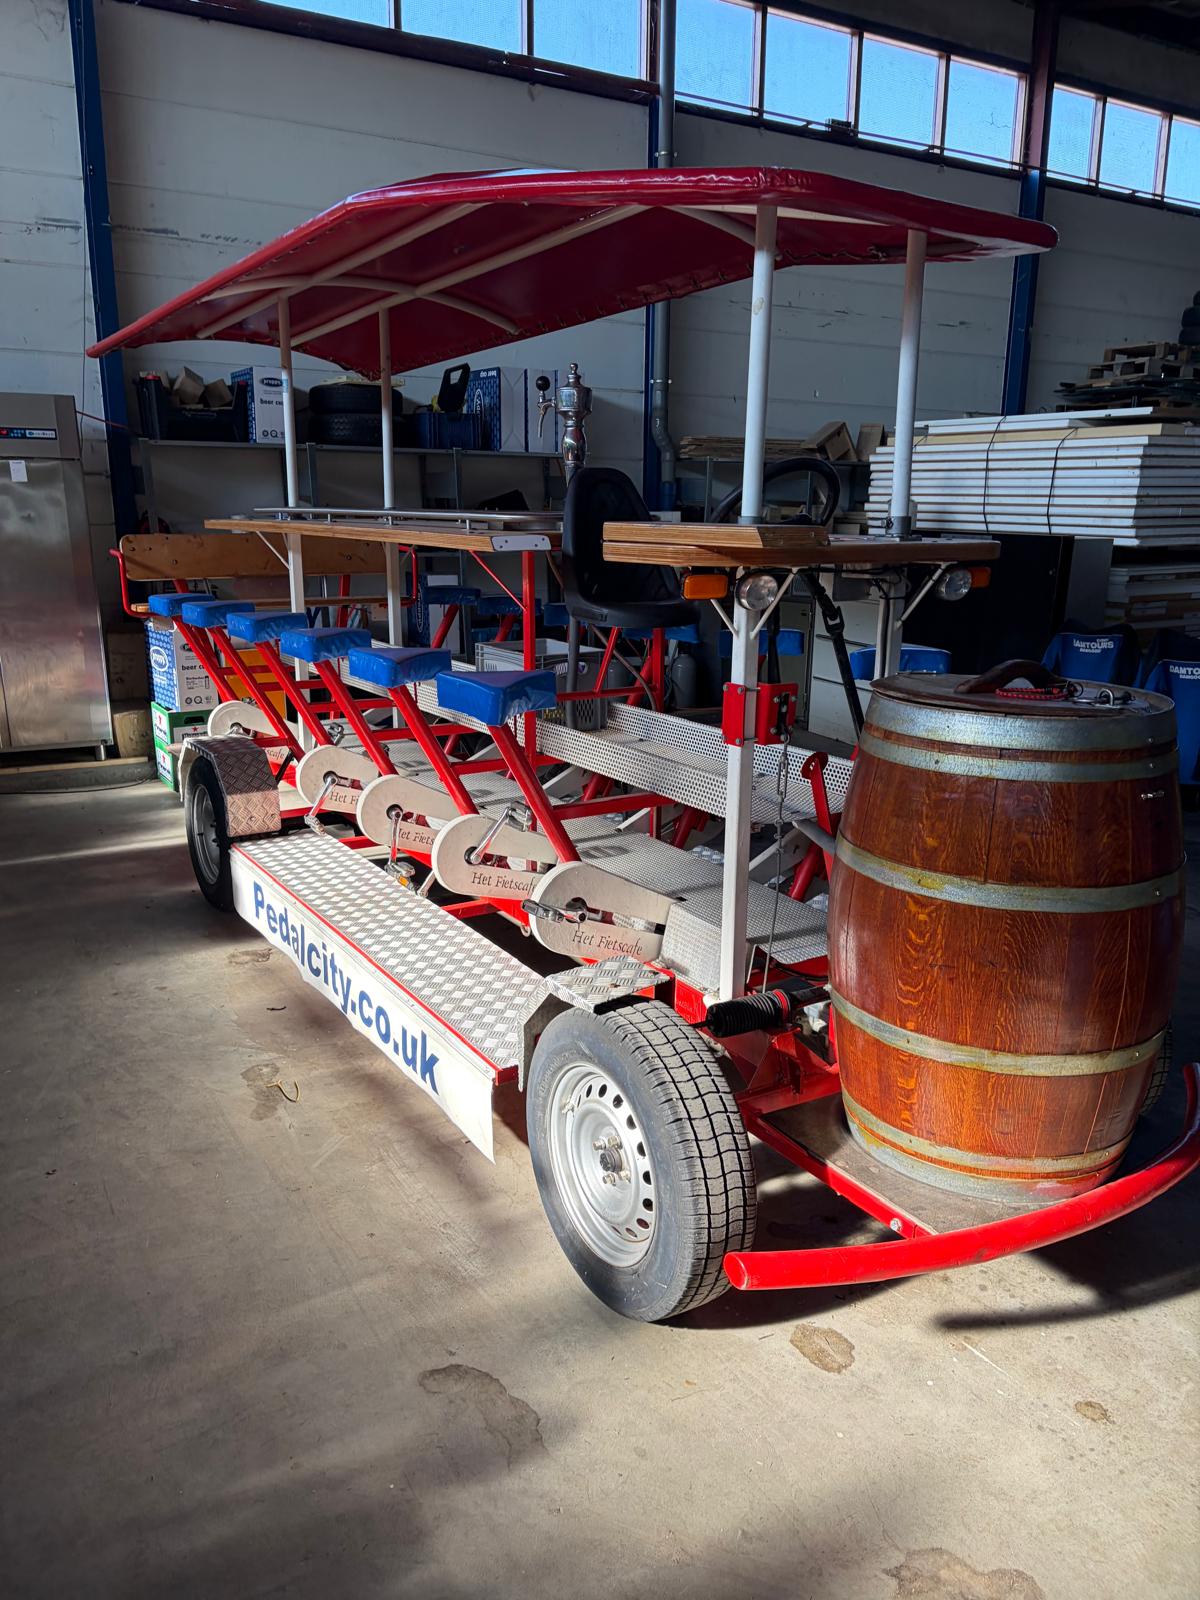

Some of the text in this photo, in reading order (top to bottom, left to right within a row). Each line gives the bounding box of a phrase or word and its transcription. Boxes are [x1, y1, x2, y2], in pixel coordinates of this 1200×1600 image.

[329, 791, 347, 804] Het
[471, 871, 492, 887] Het
[572, 930, 643, 957] Het Fietscafe
[253, 880, 440, 1096] Pedalcity.co.uk
